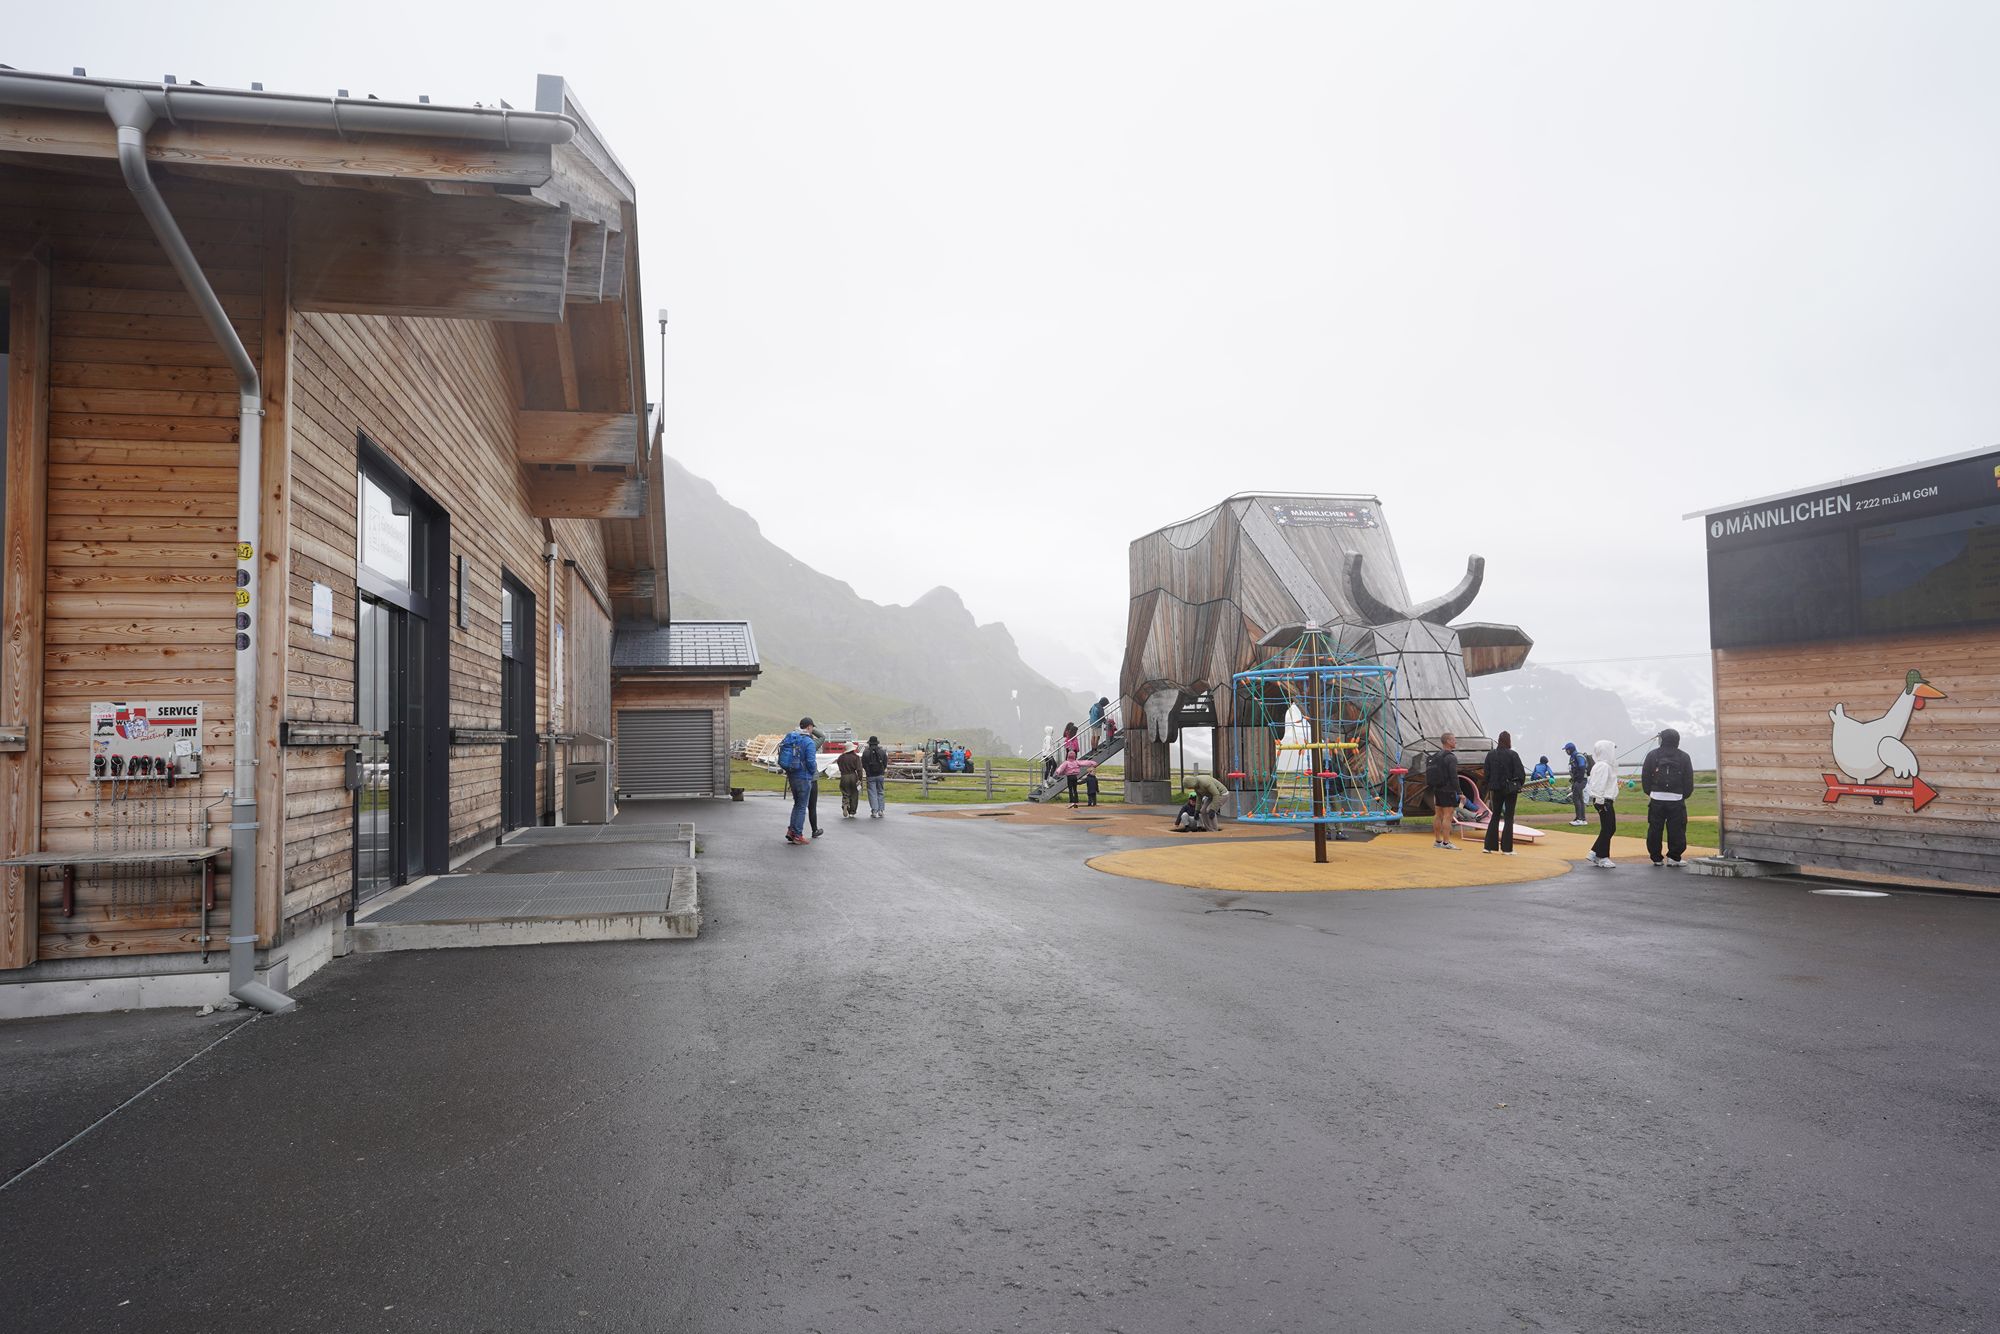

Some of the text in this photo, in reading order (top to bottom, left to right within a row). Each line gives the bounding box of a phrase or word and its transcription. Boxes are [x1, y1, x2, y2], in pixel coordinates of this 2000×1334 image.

[1726, 493, 1851, 535] MÄNNLICHEN
[1912, 486, 1938, 499] GGM
[158, 706, 198, 716] SERVICE
